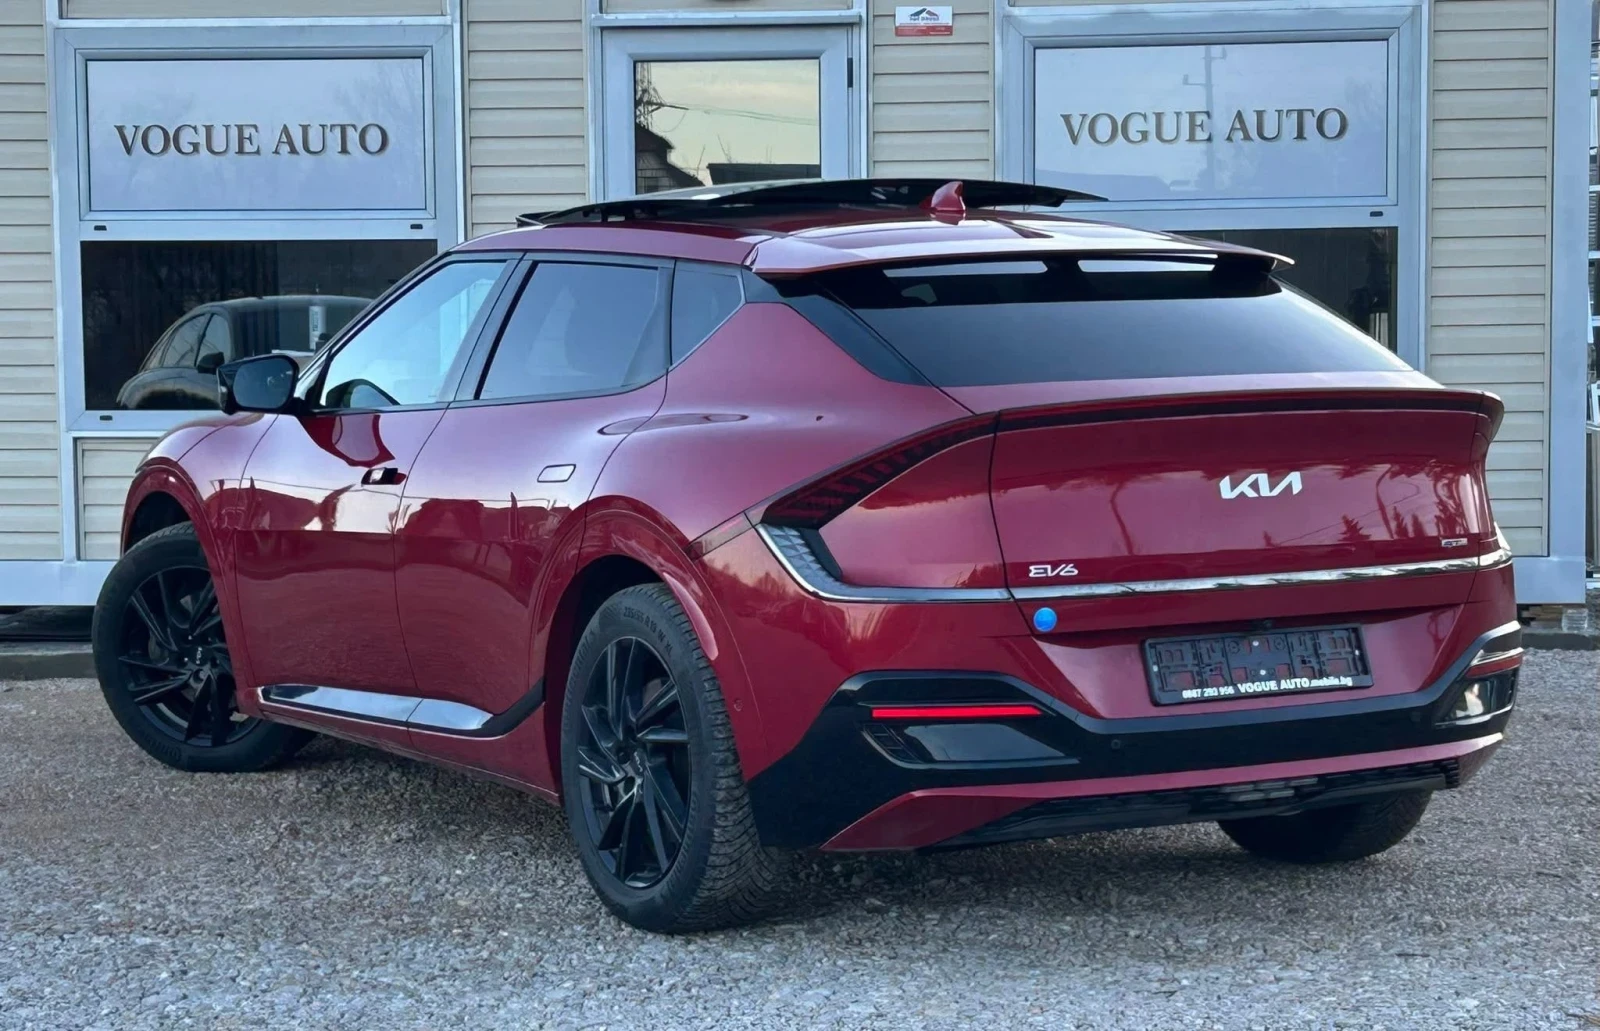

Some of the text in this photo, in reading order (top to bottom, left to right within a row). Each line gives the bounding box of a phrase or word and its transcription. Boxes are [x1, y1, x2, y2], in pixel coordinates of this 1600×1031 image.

[114, 123, 389, 156] VOGUE AUTO
[1060, 107, 1348, 146] VOGUE AUTO
[1219, 471, 1303, 500] KIA
[1028, 563, 1079, 578] EV6
[1237, 680, 1278, 693] VOGUE
